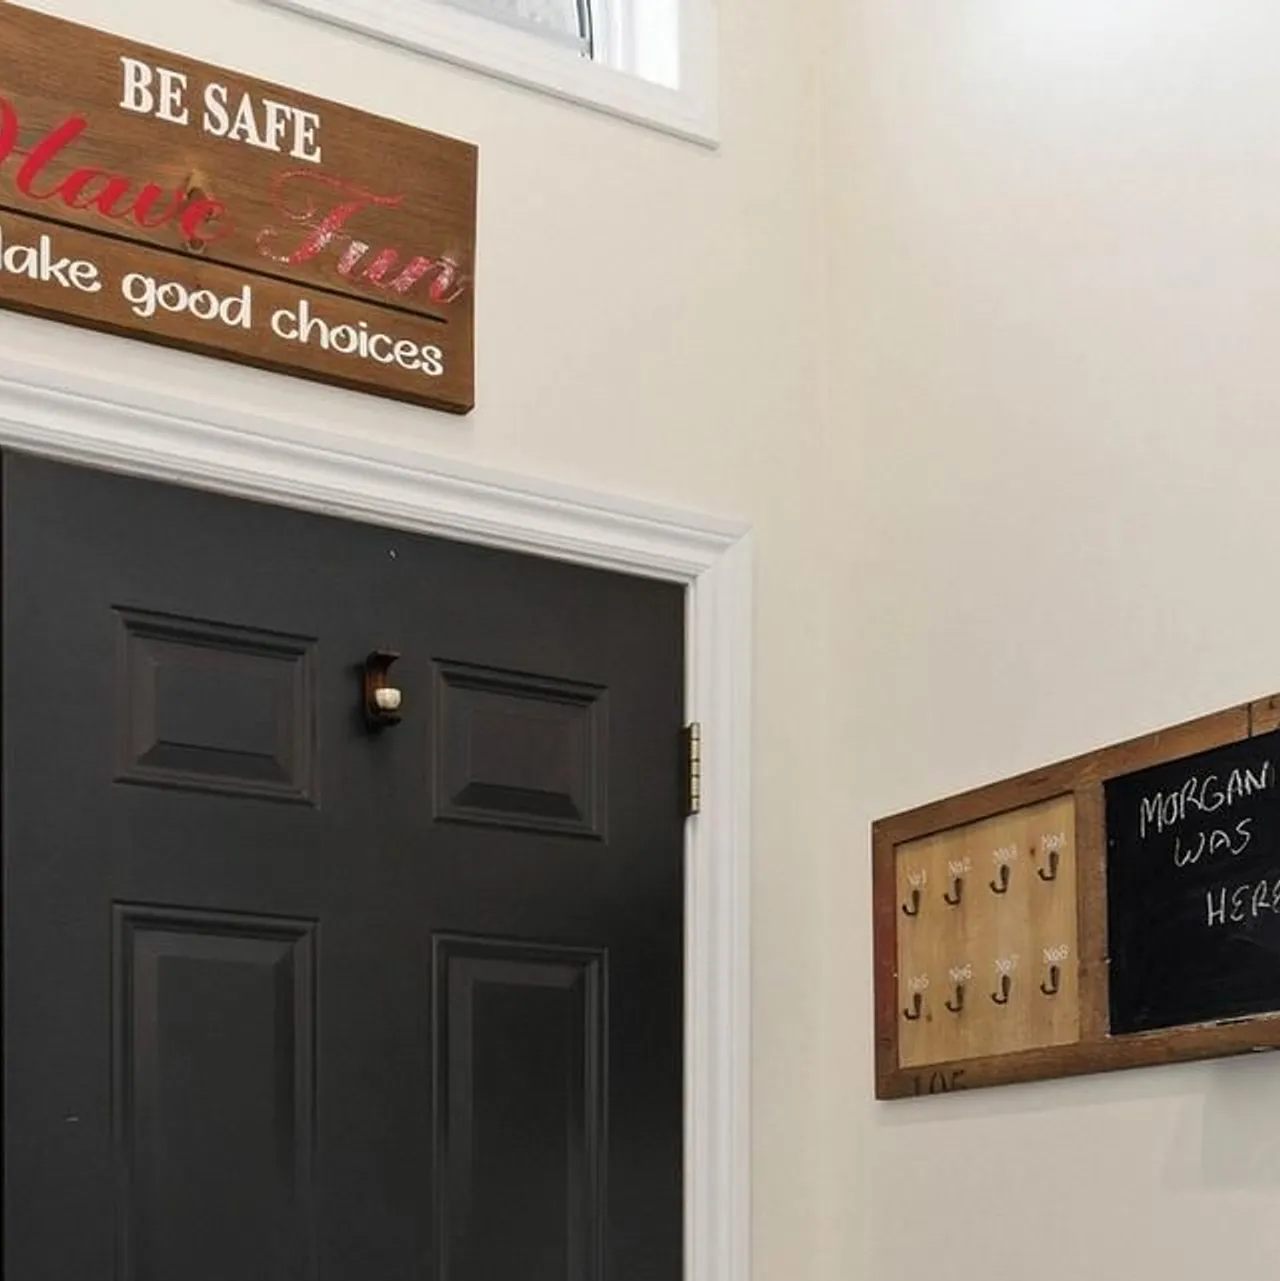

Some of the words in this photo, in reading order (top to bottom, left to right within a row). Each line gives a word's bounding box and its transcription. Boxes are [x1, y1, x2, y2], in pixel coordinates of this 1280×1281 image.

[119, 56, 189, 126] BE
[203, 82, 322, 163] SAFE
[255, 166, 470, 304] Fun
[121, 270, 252, 330] good
[271, 299, 445, 377] choices
[1139, 760, 1271, 839] MORGAN
[1173, 817, 1253, 868] WAS
